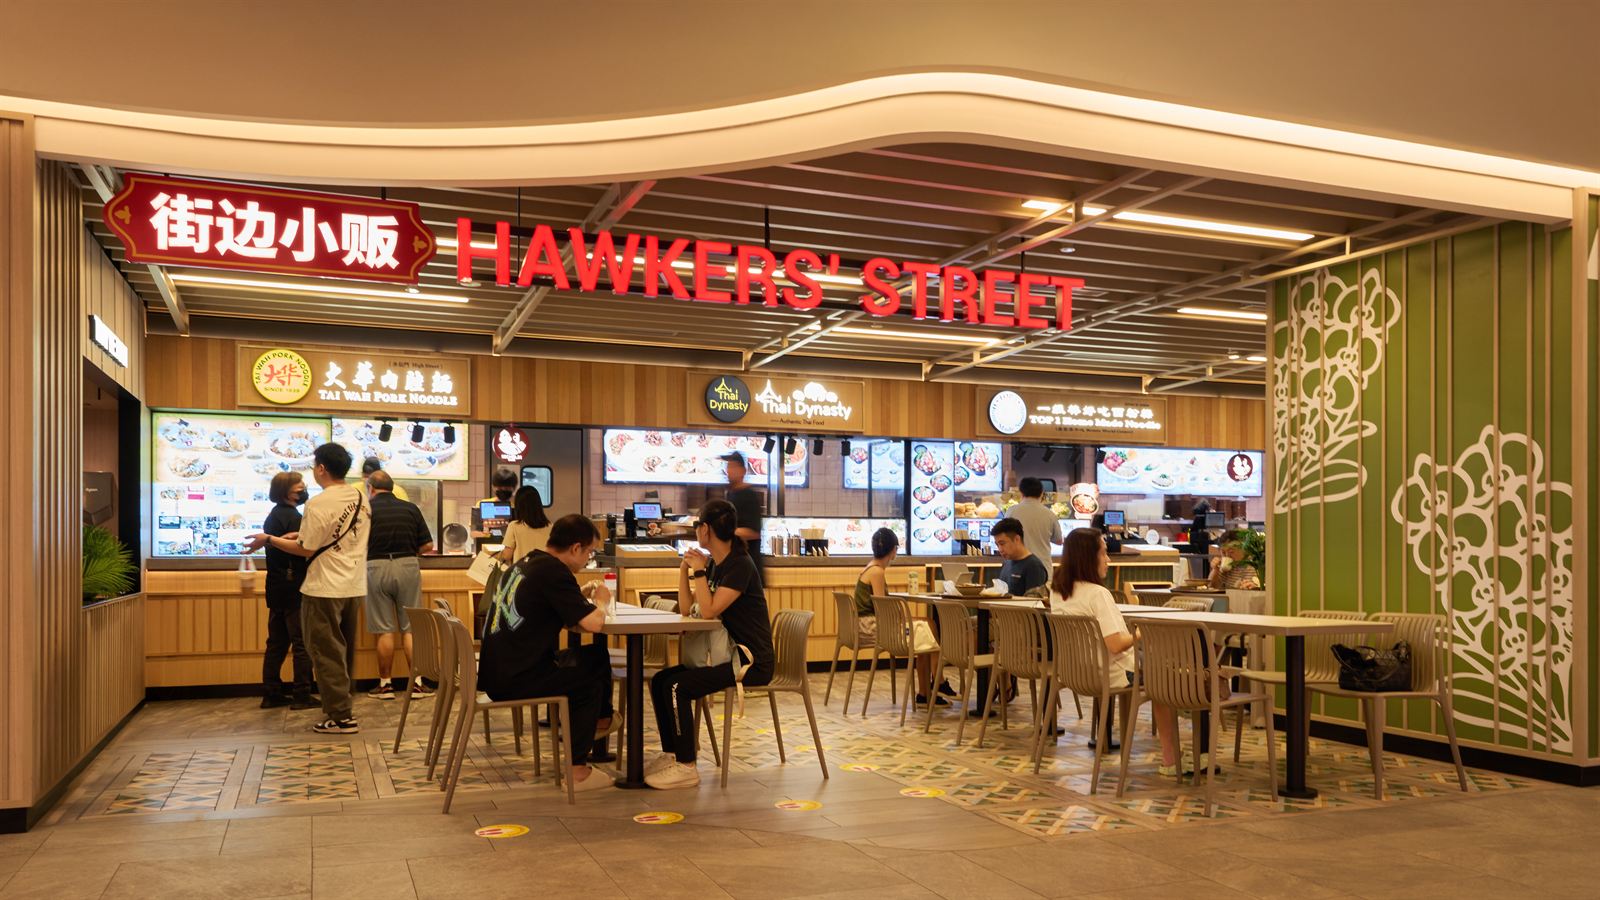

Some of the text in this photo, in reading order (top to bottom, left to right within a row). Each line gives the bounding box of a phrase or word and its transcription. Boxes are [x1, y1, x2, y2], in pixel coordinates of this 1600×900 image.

[149, 192, 400, 269] 街边小贩
[456, 217, 1085, 330] HAWKERS' STREET
[256, 355, 271, 370] WAH
[296, 358, 310, 387] NOODLE
[318, 389, 458, 406] TAI WAH PORK NOODLE
[718, 388, 738, 401] Thai
[709, 399, 749, 413] Dynasty
[762, 397, 852, 420] Thai Dynasty
[1029, 414, 1054, 424] TOP
[1055, 416, 1061, 425] 1
[1062, 416, 1093, 426] Home
[1095, 418, 1123, 427] Made
